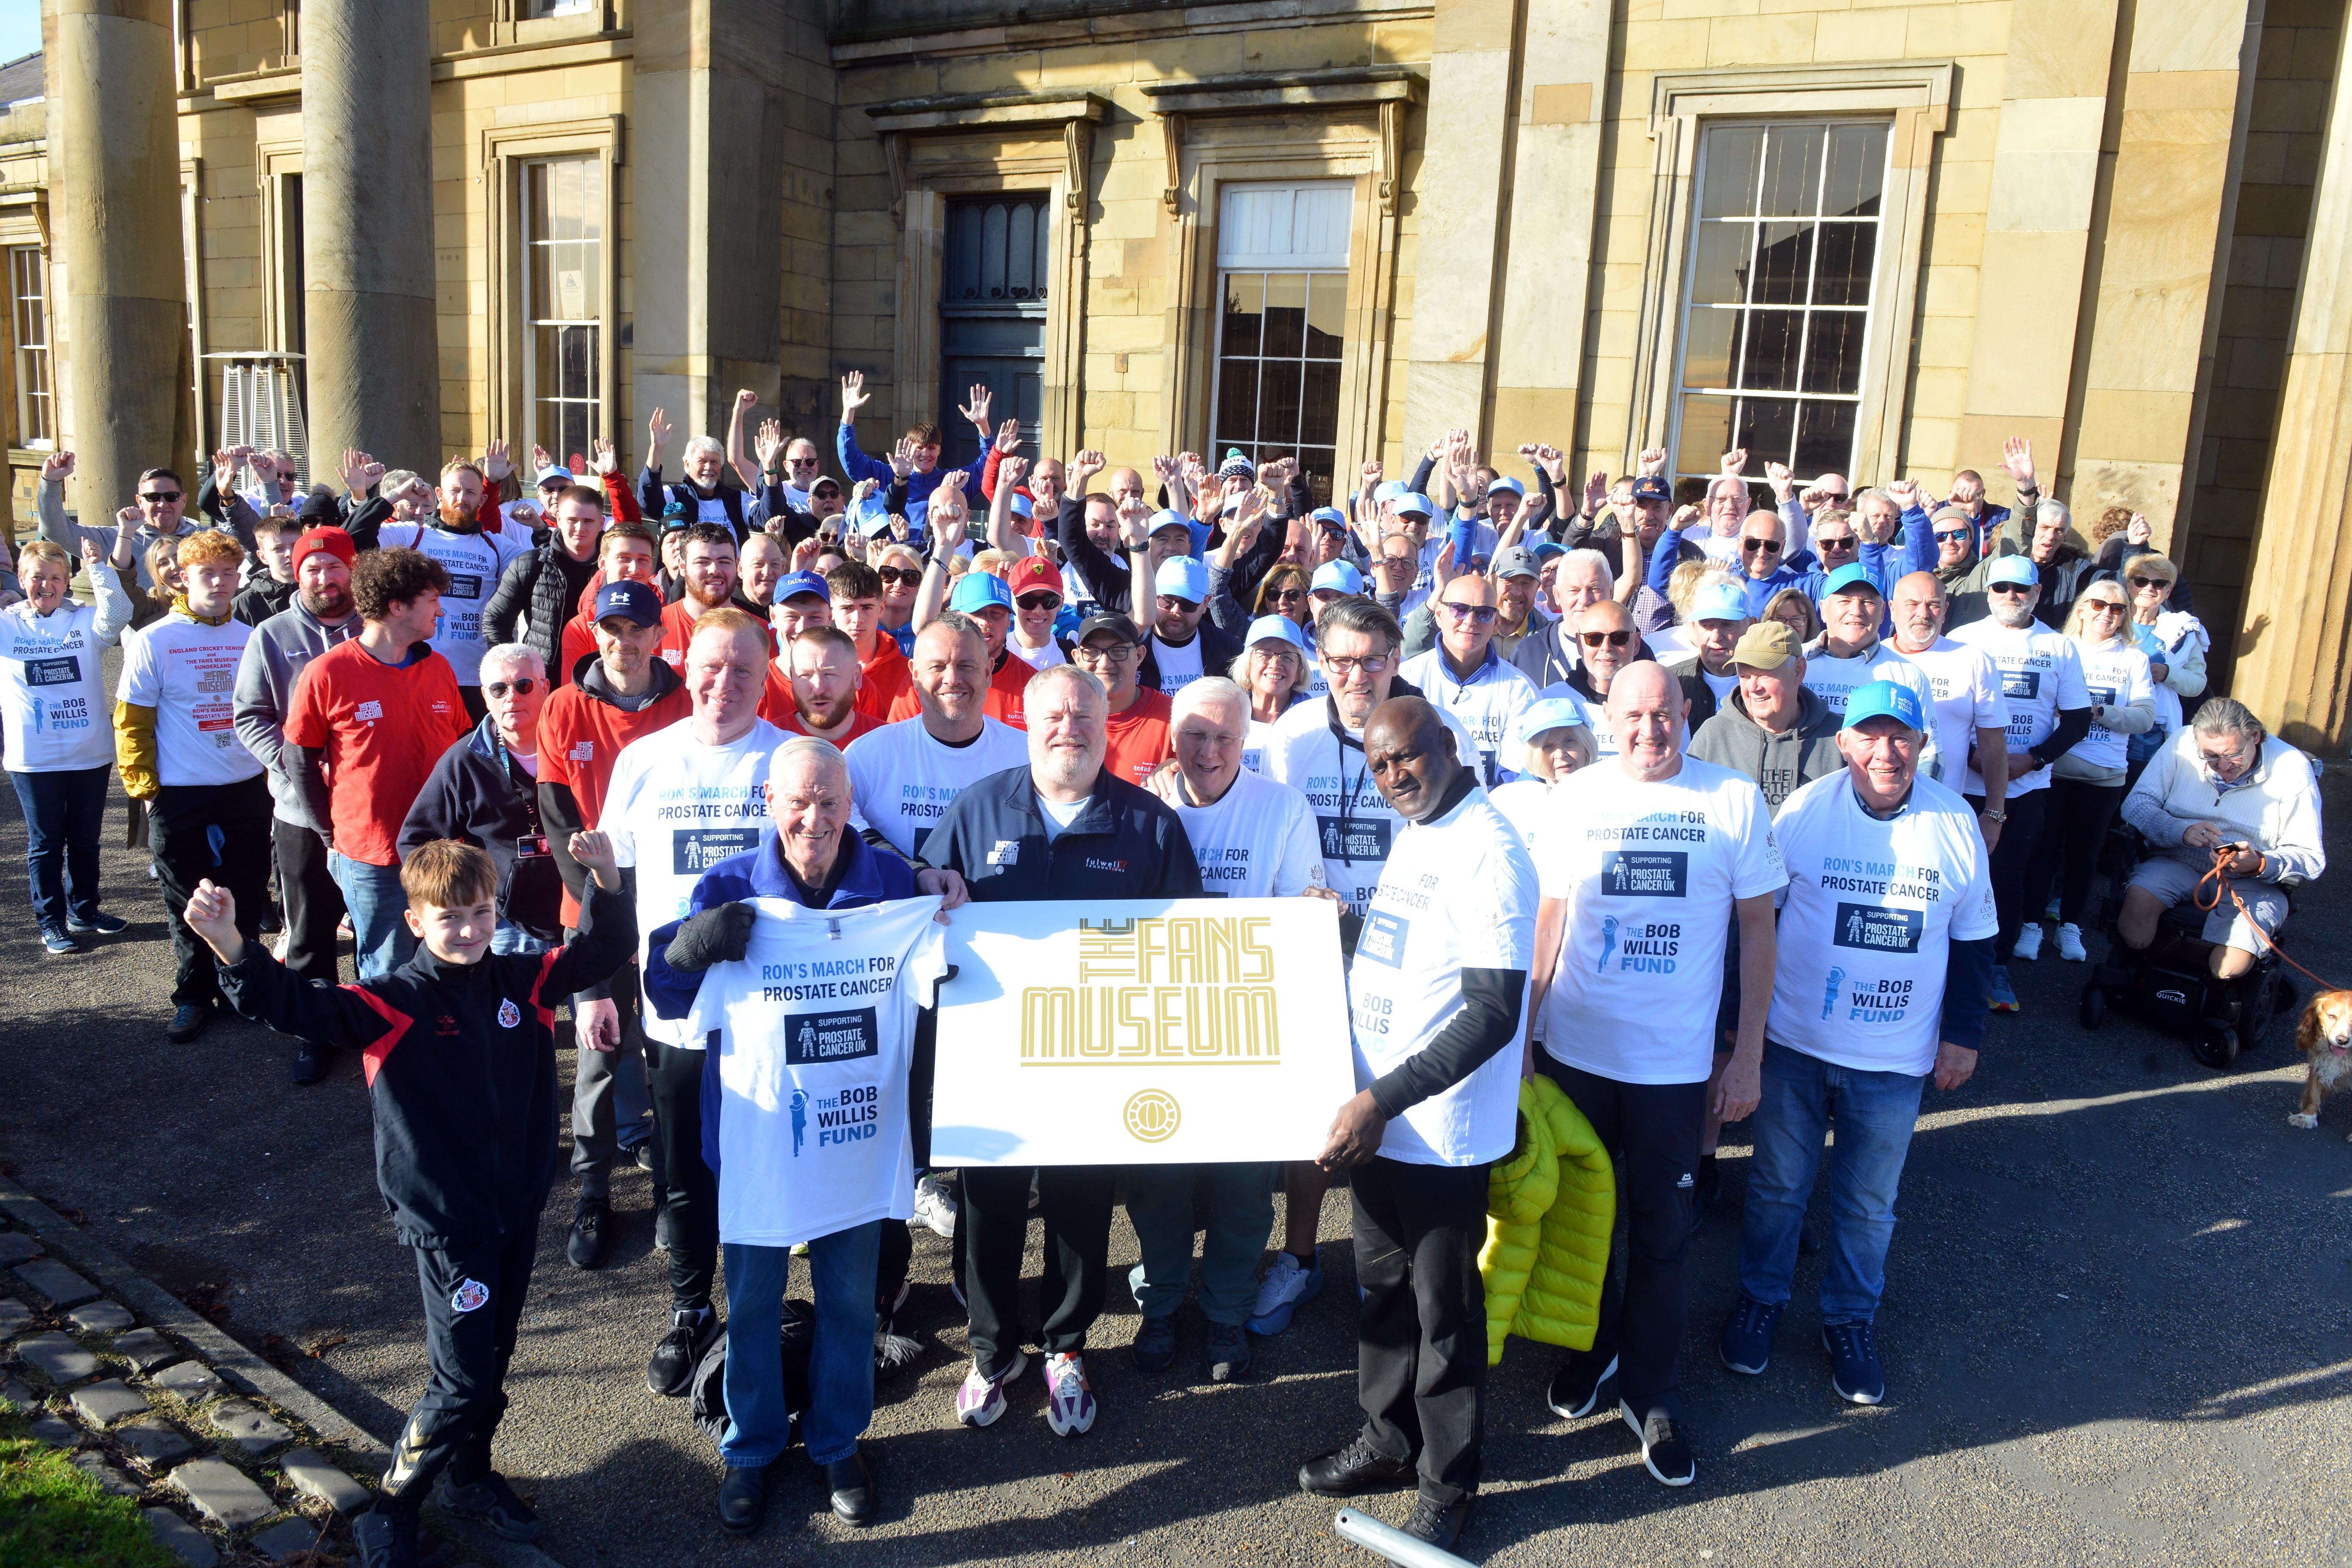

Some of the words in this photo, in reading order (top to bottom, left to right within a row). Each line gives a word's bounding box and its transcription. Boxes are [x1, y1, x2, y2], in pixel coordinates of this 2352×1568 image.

[428, 549, 450, 557] RON'S
[452, 550, 476, 561] MARCH
[465, 562, 490, 572] CANCER
[462, 613, 480, 621] BOB
[451, 622, 480, 631] WILLIS
[69, 630, 81, 639] OR
[451, 631, 478, 640] FUND
[54, 640, 84, 653] CANCER
[2035, 650, 2050, 659] FOR
[1993, 656, 2015, 664] STATE
[2018, 657, 2051, 668] CANCER
[44, 667, 70, 676] PROSTATE
[45, 674, 66, 682] CANCER
[1175, 674, 1199, 684] MARC
[1932, 677, 1949, 686] FOR
[2096, 674, 2127, 684] CANCER
[1827, 683, 1856, 694] MARC
[1931, 689, 1948, 698] CER
[63, 698, 86, 708] BOB
[1898, 700, 1913, 712] WILLIS
[50, 708, 88, 720] WILLIS
[355, 708, 383, 721] MUSEUM
[1898, 705, 1912, 716] FUND
[52, 718, 89, 730] FUND
[2012, 715, 2033, 724] BOB
[2004, 726, 2032, 735] ILLIS
[2007, 735, 2029, 745] UND
[570, 750, 592, 760] MUSEUM
[1763, 769, 1791, 781] THE
[1306, 777, 1338, 789] RON'S
[1762, 781, 1790, 793] RTH
[660, 787, 696, 801] RON'S
[700, 786, 747, 799] MARCH
[752, 786, 766, 799] FO
[902, 784, 936, 799] RON'S
[658, 805, 721, 819] PROSTATE
[724, 804, 768, 817] CANCE
[901, 803, 947, 818] PROSTA
[1680, 811, 1705, 824] FOR
[1587, 827, 1649, 841] PROSTATE
[1652, 827, 1705, 842] CANCER
[1193, 847, 1223, 861] ARCH
[1225, 849, 1249, 861] FOR
[1370, 845, 1380, 856] UK
[1086, 857, 1120, 868] fulwell
[1086, 865, 1125, 873] PRODUCTIONS
[1200, 866, 1247, 880] CANCER
[1631, 869, 1671, 880] PROSTATE
[1823, 857, 1862, 873] RON'S
[1866, 862, 1914, 879] MARCH
[1918, 868, 1940, 884] FOR
[1418, 874, 1438, 890] FOR
[1631, 880, 1662, 891] CANCER
[1663, 880, 1675, 891] UK
[1356, 886, 1377, 901] BO
[1821, 875, 1887, 895] PROSTATE
[1890, 883, 1939, 902] CANCER
[1867, 911, 1908, 922] SUPPORTING
[1626, 927, 1643, 938] THE
[1646, 924, 1680, 938] BOB
[1865, 922, 1908, 937] PROSTATE
[1864, 933, 1898, 947] CANCER
[1898, 937, 1910, 948] UK
[1079, 917, 1135, 983] THE
[1137, 916, 1275, 984] FANS
[1623, 940, 1678, 956] WILLIS
[763, 963, 807, 980] RON'S
[812, 959, 865, 977] MARCH
[869, 957, 895, 972] FOR
[1620, 957, 1676, 974] FUND
[764, 983, 836, 1001] PROSTATE
[840, 977, 892, 996] CANCER
[1854, 981, 1876, 992] THE
[1878, 980, 1913, 993] BOB
[1363, 993, 1392, 1015] BOB
[1852, 992, 1909, 1008] WILLIS
[2157, 992, 2186, 1004] QUICKIE
[818, 1015, 862, 1026] SUPPORTING
[1849, 1008, 1905, 1023] FUND
[1020, 986, 1280, 1058] MUSEUM
[819, 1028, 862, 1044] PROSTATE
[819, 1042, 854, 1057] CANCER
[855, 1039, 866, 1052] UK
[817, 1098, 838, 1109] THE
[840, 1086, 877, 1106] BOB
[817, 1104, 877, 1128] WILLIS
[819, 1123, 877, 1147] FUND
